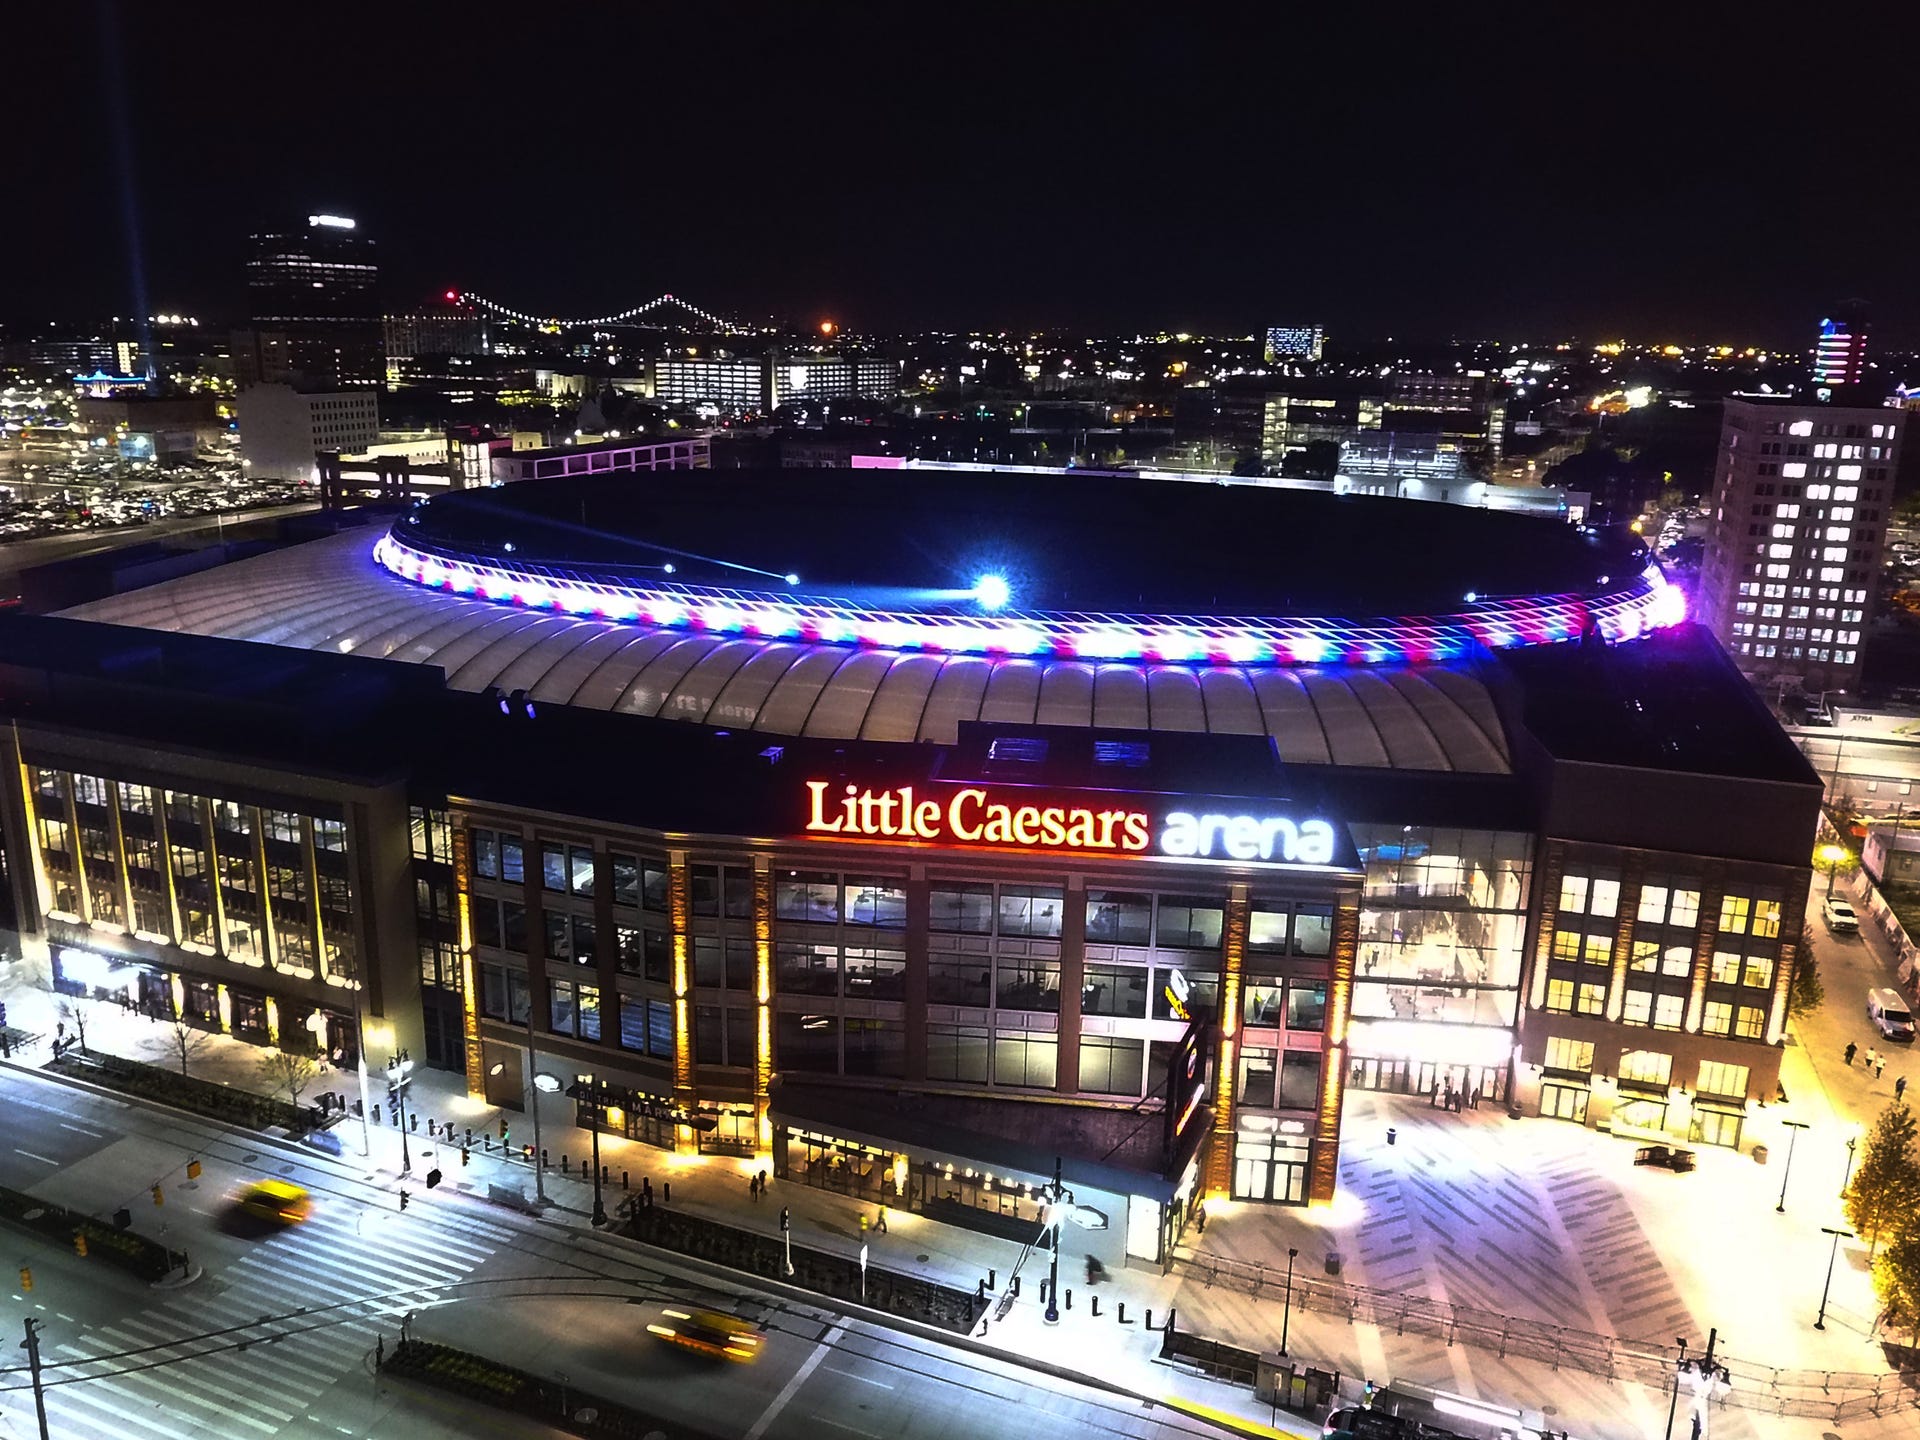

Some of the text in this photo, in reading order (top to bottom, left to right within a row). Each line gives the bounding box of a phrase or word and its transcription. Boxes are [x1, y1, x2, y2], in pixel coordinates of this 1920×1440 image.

[805, 781, 1334, 863] Little Caesars arena
[579, 1090, 626, 1107] DITRICT
